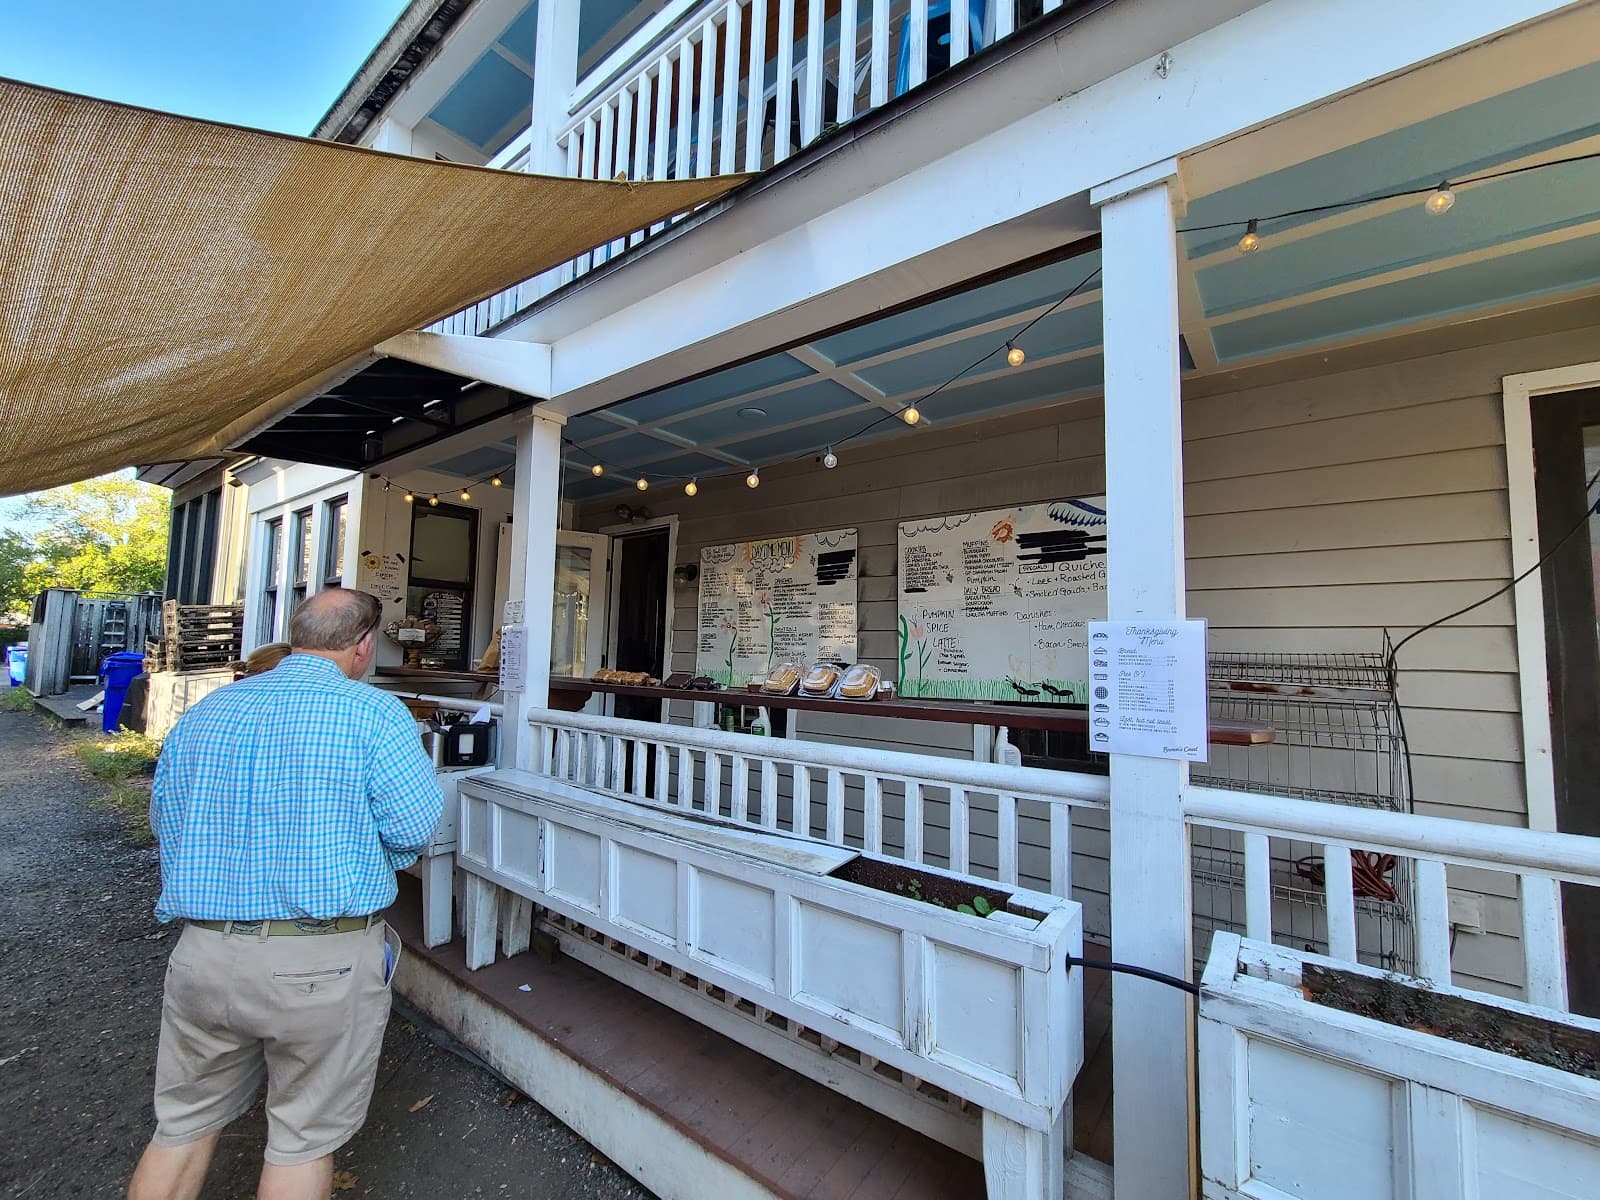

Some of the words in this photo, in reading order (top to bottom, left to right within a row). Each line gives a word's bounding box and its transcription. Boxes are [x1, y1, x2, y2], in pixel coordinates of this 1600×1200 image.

[1060, 571, 1096, 582] Roasted
[981, 585, 1001, 594] BREAD
[922, 609, 955, 619] PUMPKIN
[926, 622, 949, 633] SPICE
[1125, 626, 1178, 638] Thanksgiving
[1139, 636, 1165, 647] Menu
